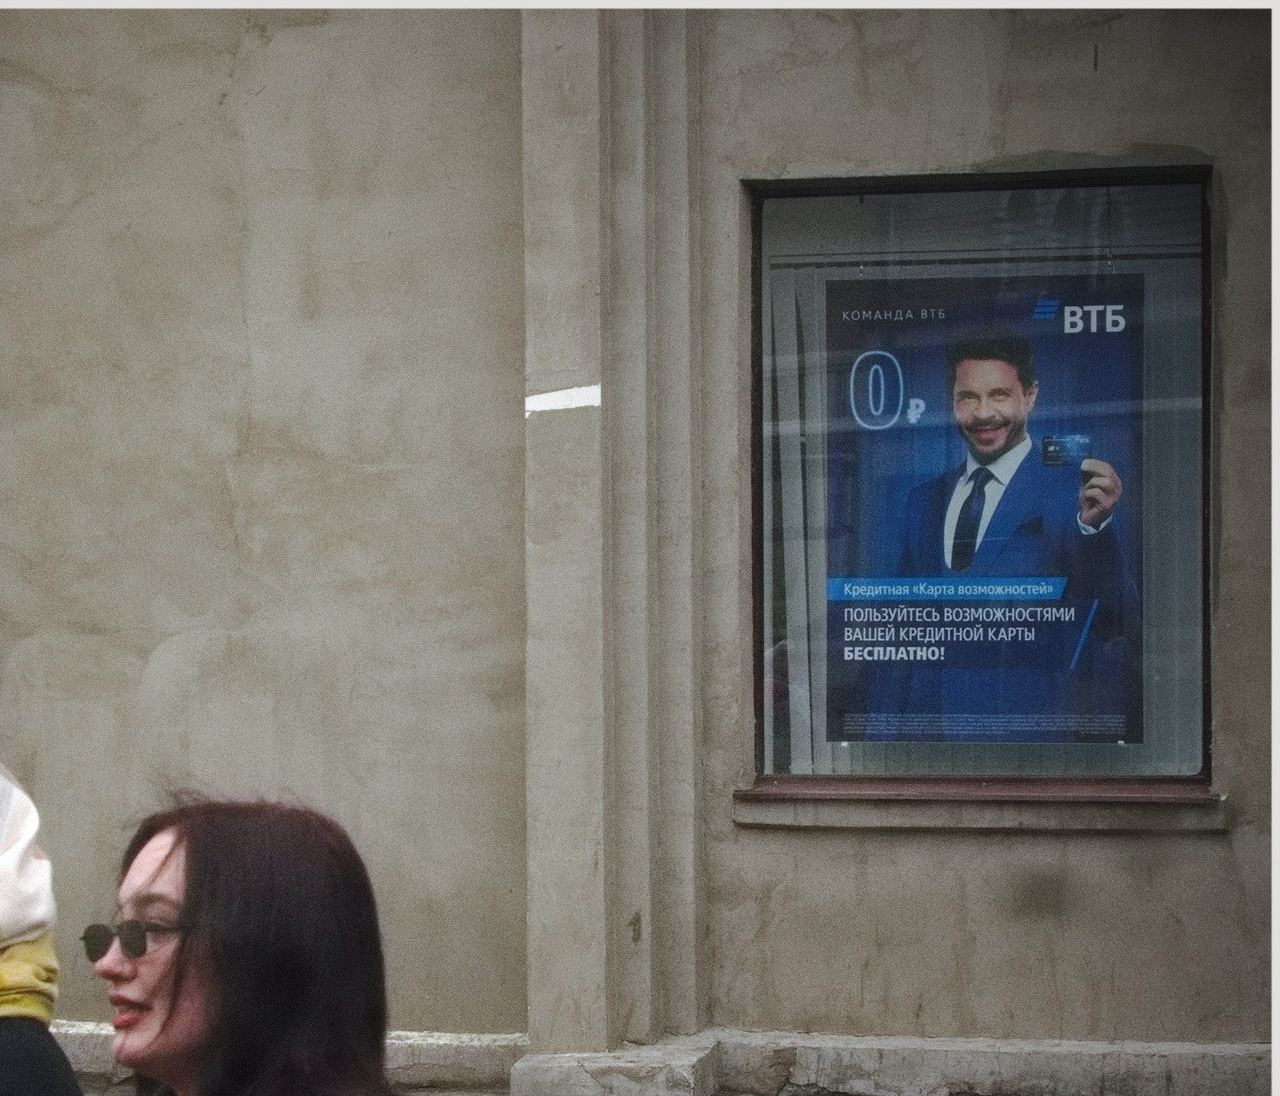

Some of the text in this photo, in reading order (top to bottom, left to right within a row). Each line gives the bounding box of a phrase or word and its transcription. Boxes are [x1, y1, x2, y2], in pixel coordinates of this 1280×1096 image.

[842, 308, 946, 321] КОМАНДА ВТБ
[1063, 304, 1126, 334] ВТБ
[843, 581, 1054, 598] Кредитная «Карта возможностей»
[843, 604, 1076, 622] ПОЛЬЗУЙТЕСЬ ВОЗМОЖНОСТЯМИ
[843, 624, 1036, 643] ВАШЕЙ КРЕДИТНОЙ КАРТЫ
[843, 646, 946, 661] БЕСПЛАТНО!
